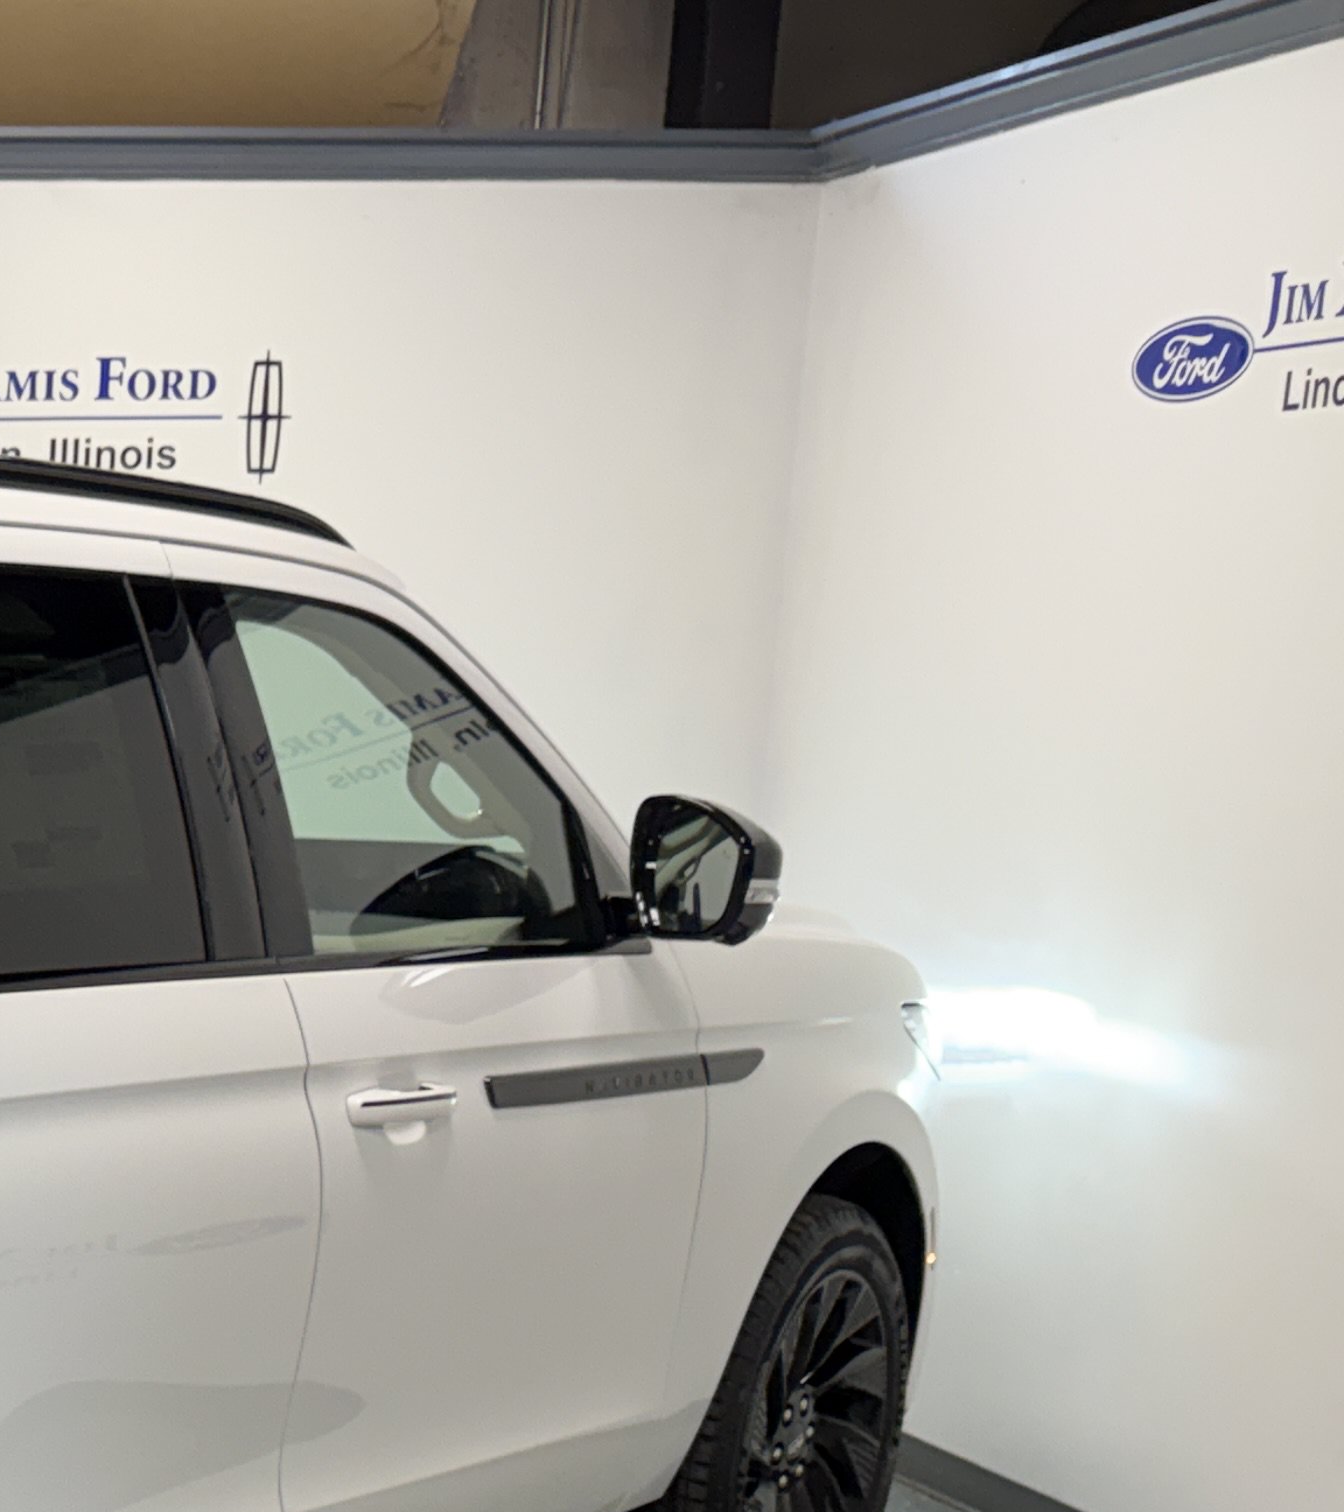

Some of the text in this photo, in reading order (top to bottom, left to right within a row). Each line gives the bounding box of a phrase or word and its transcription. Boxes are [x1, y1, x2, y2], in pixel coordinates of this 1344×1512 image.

[94, 356, 217, 402] FORD
[1152, 332, 1231, 390] Ford
[49, 436, 177, 470] Illinois
